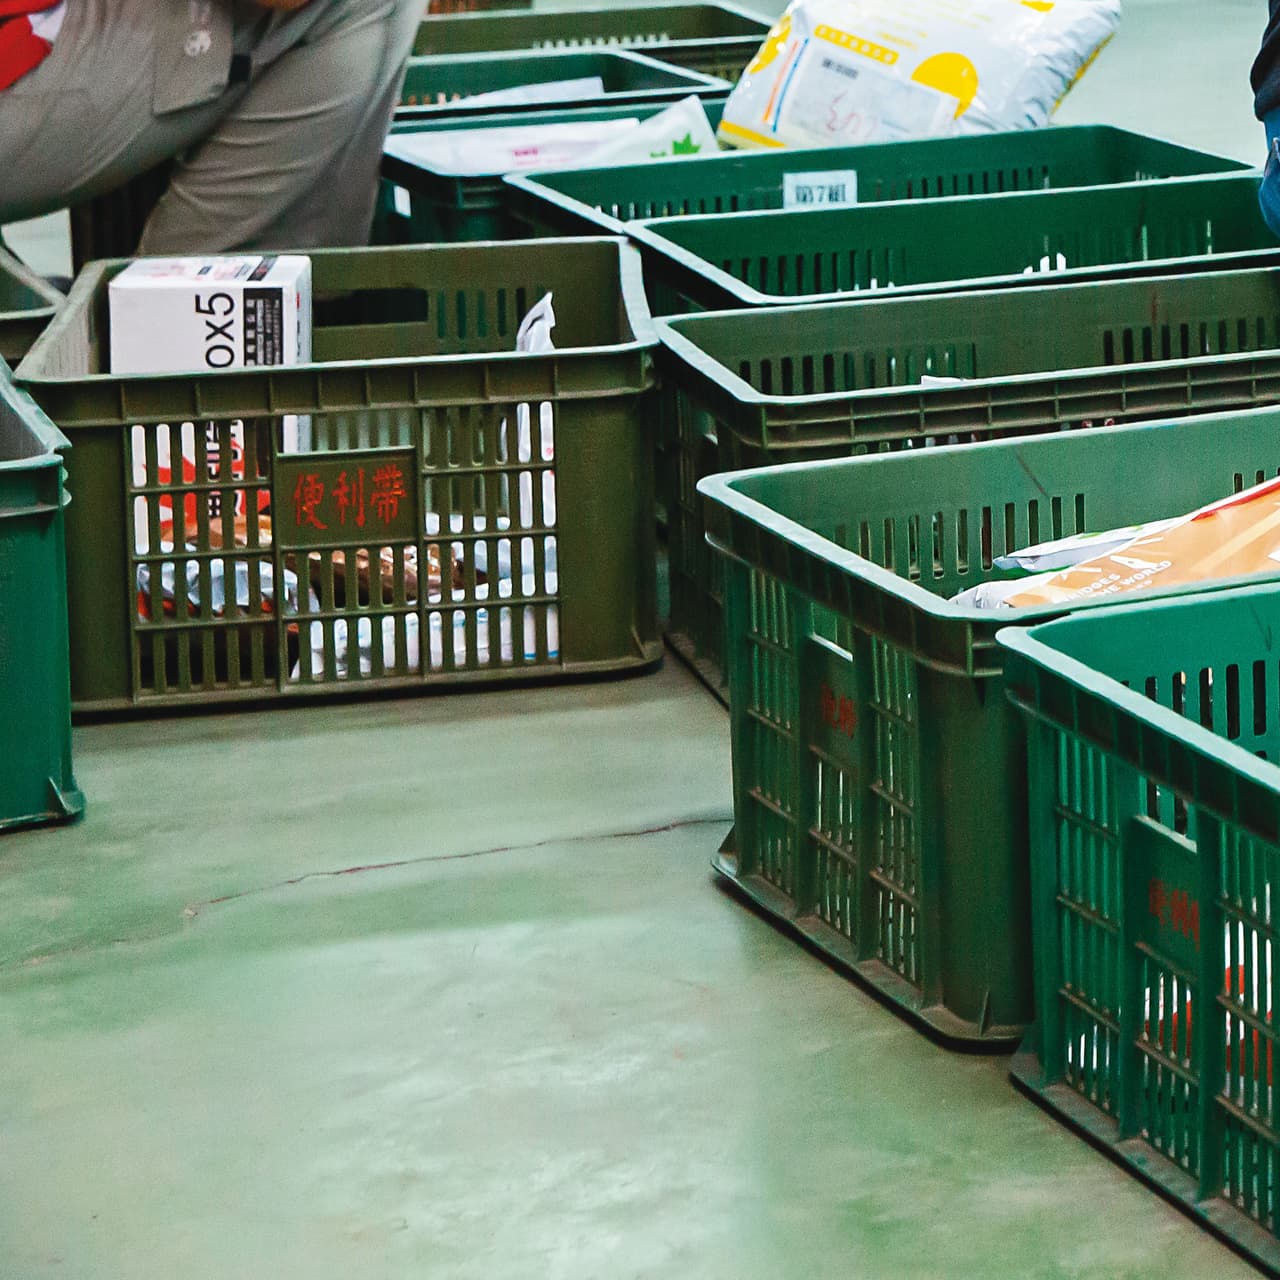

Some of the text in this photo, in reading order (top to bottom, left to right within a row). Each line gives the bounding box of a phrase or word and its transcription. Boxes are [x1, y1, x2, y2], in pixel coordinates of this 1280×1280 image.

[195, 292, 236, 368] ox5
[292, 463, 408, 530] 便利帶
